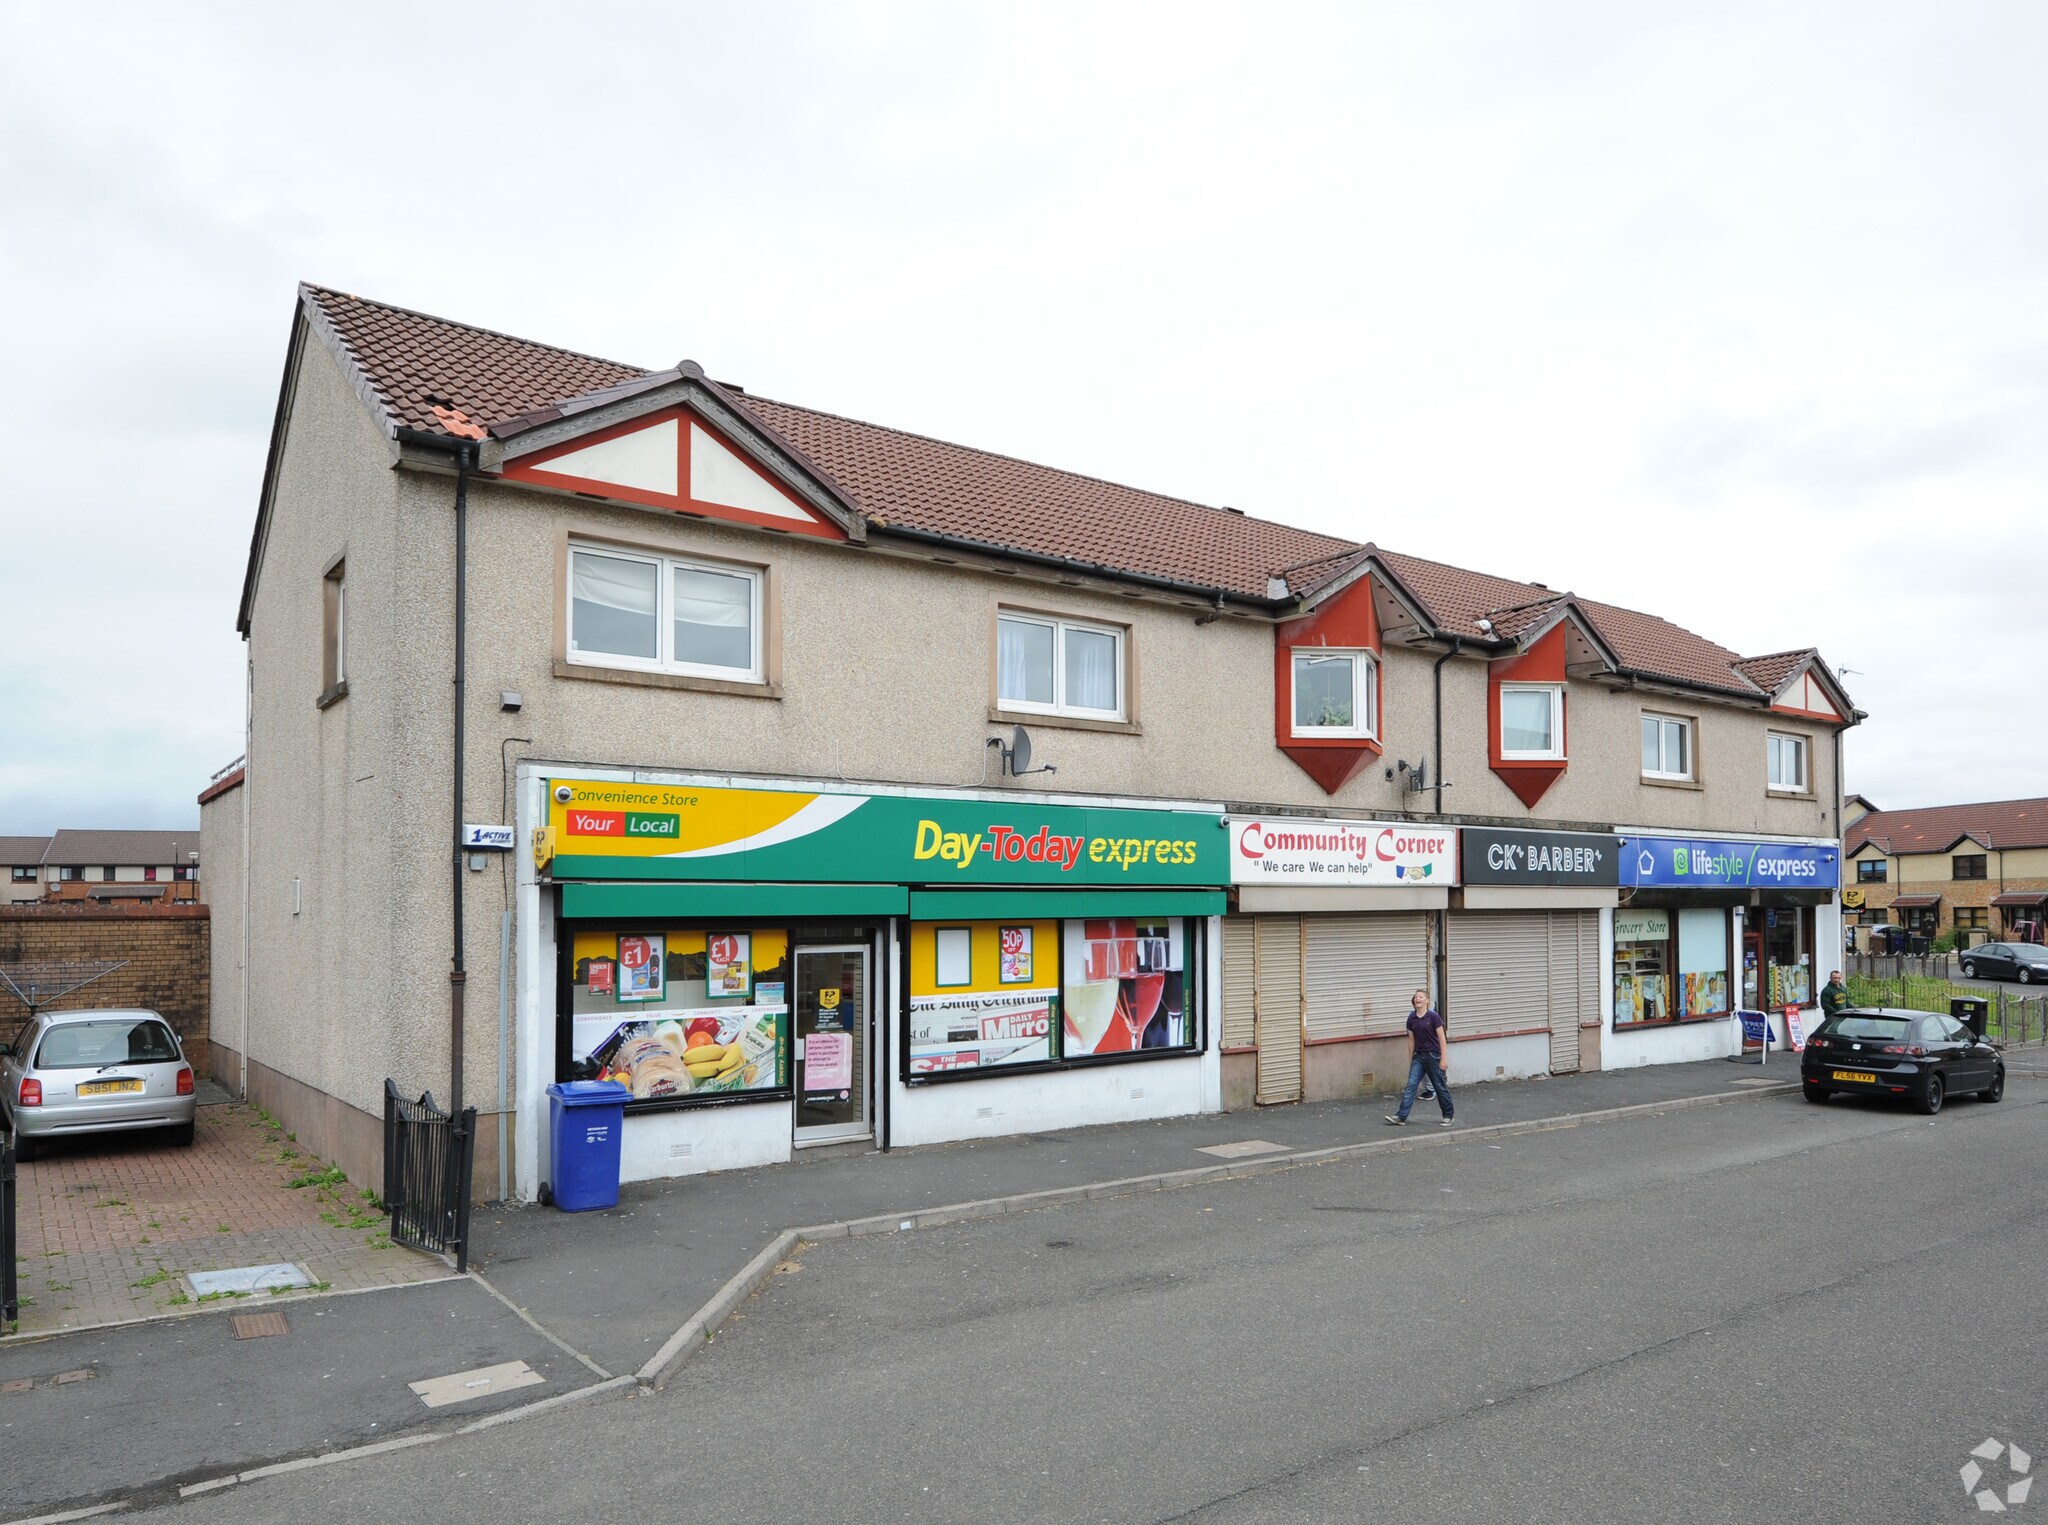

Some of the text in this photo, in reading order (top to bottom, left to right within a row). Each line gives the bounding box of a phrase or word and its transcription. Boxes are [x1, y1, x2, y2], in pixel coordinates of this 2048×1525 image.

[570, 787, 699, 807] Convenience Store
[575, 814, 674, 834] Your Local
[482, 831, 512, 840] ACTIVE
[913, 819, 1197, 872] Day-Today express
[1239, 822, 1445, 862] Community Corner
[1282, 863, 1305, 873] care
[1309, 861, 1325, 873] We
[1327, 864, 1345, 873] can
[1692, 849, 1816, 883] lifestyle express
[1646, 919, 1667, 934] Store
[624, 945, 642, 965] £1
[711, 935, 731, 959] £1
[1010, 1012, 1033, 1024] DAILY
[940, 1055, 957, 1063] THE
[777, 1059, 785, 1085] Grocery
[86, 1081, 136, 1094] SB51 JNZ
